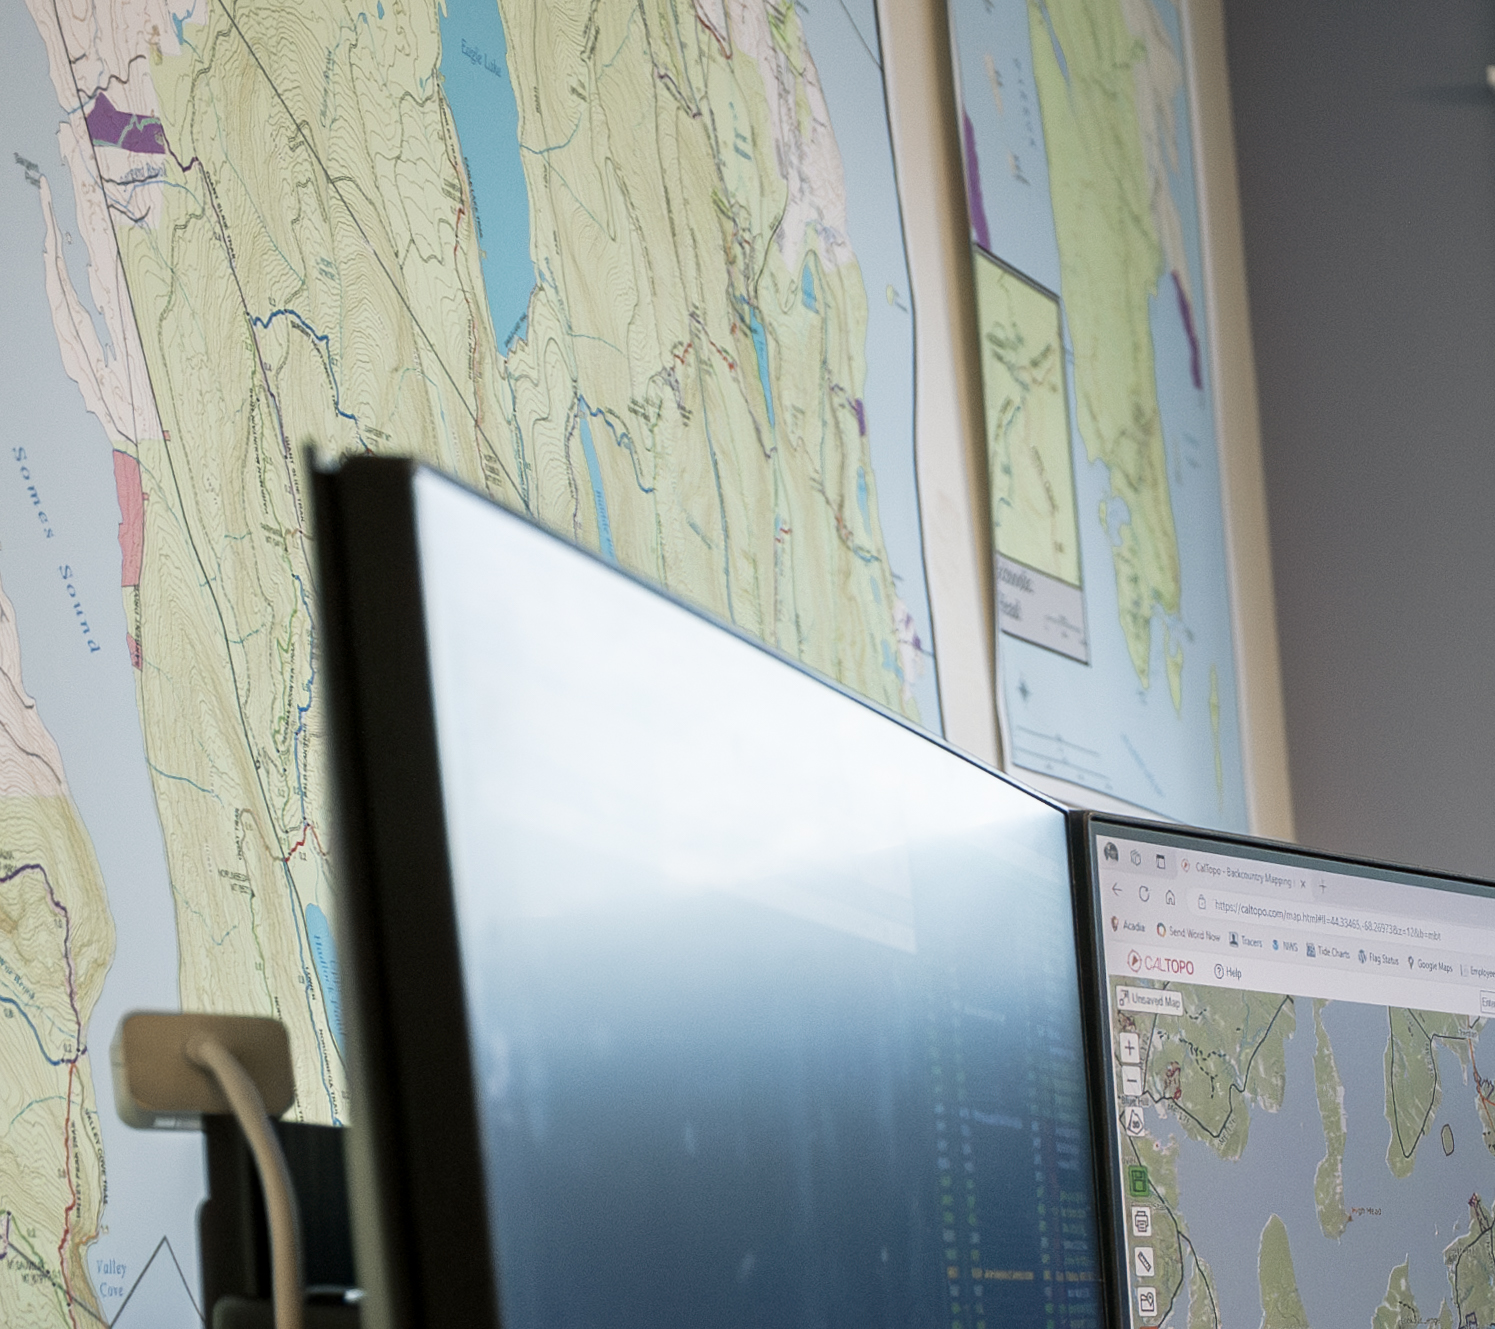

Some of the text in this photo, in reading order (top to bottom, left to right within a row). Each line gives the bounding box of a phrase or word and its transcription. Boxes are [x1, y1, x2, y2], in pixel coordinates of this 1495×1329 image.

[461, 38, 501, 78] Eagle Lake
[12, 446, 101, 653] Somes Sound
[1195, 861, 1292, 889] CalTopo Backcountry Mapping
[1122, 919, 1146, 933] Acadia
[1169, 925, 1221, 942] Send Word Now
[1241, 933, 1263, 948] Tracers
[1282, 940, 1298, 953] NWS
[1317, 944, 1350, 959] Tide Charts
[1369, 952, 1399, 966] Flag Status
[1144, 955, 1194, 975] CALTOPO
[1225, 966, 1242, 980] Help
[1417, 960, 1453, 974] Google Maps
[1131, 992, 1181, 1010] Unsaved Map
[85, 1107, 100, 1145] VALLEY
[97, 1259, 127, 1297] Valley Cove
